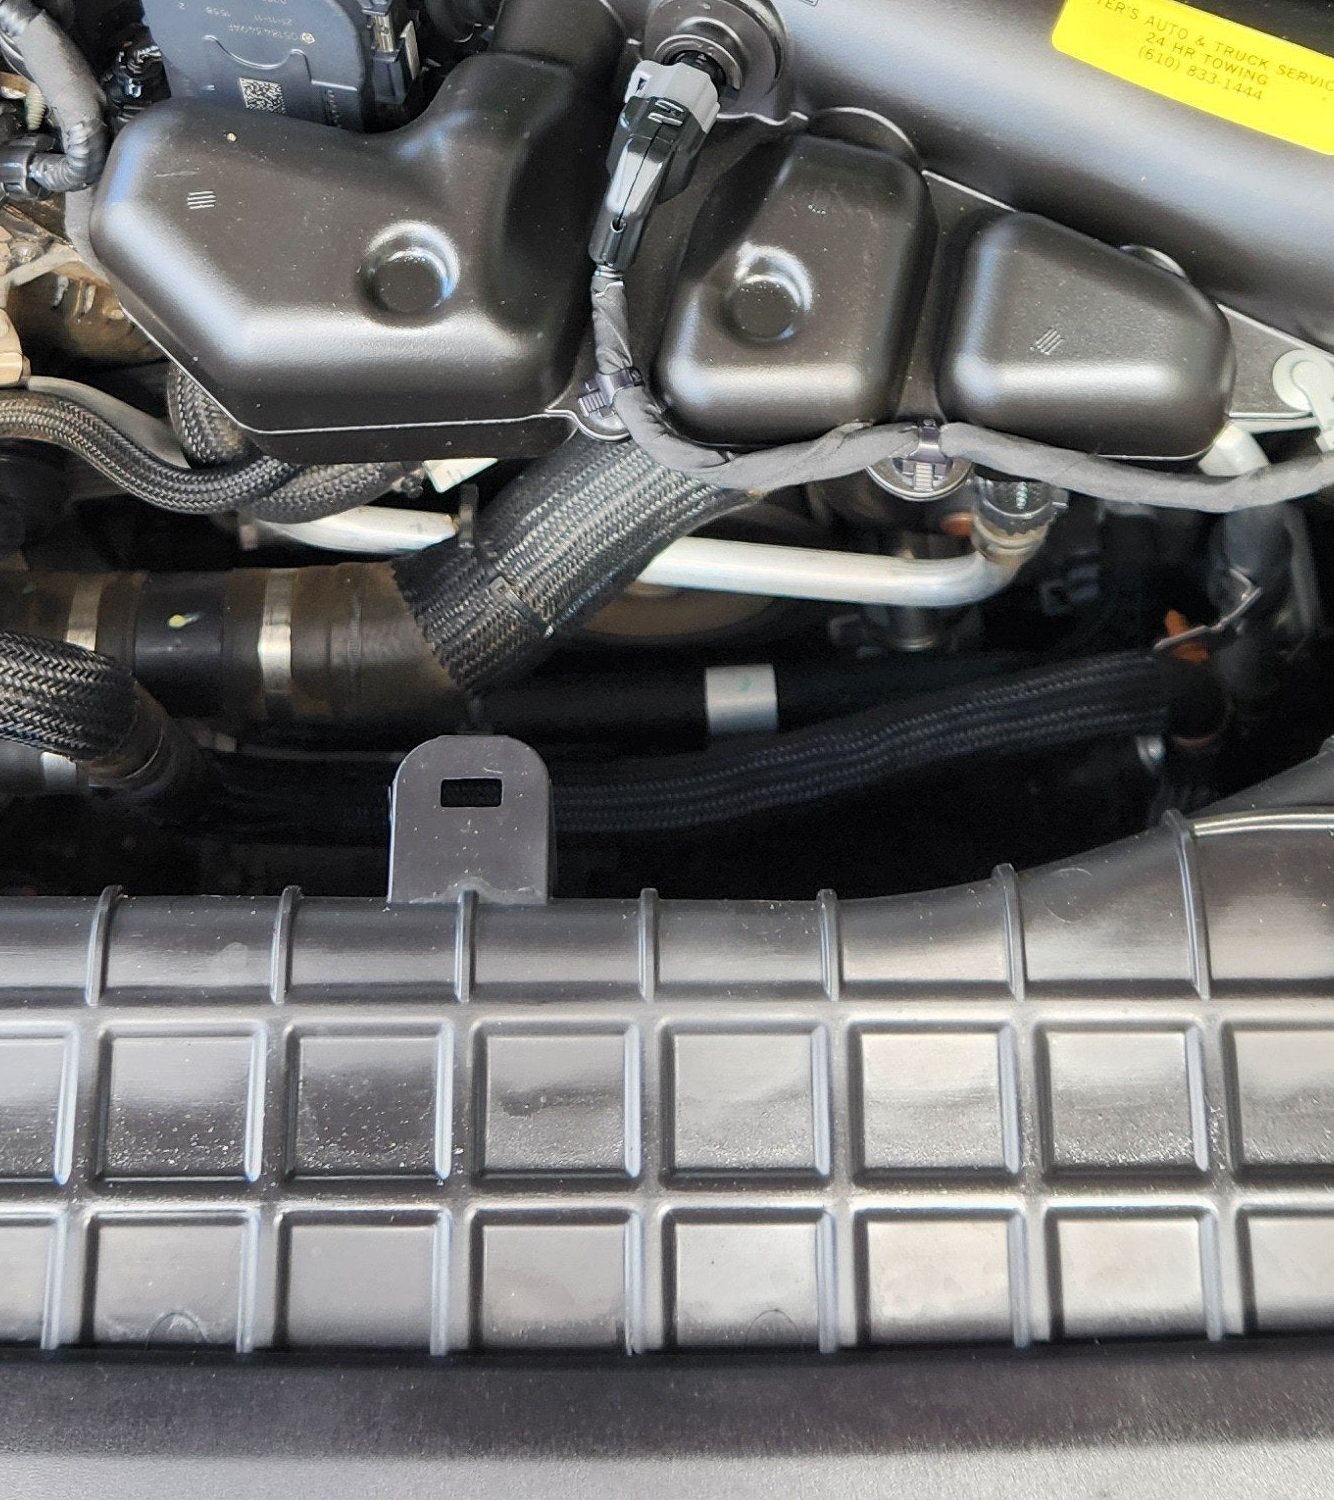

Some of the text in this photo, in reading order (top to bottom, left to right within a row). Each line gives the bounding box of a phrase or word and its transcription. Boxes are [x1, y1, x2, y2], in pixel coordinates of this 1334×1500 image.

[1145, 15, 1189, 40] AUTO
[1194, 36, 1206, 47] &
[1214, 41, 1270, 70] TRUCK
[1145, 32, 1269, 86] 24 HR TOWING
[1137, 45, 1264, 102] (610) 833-1444
